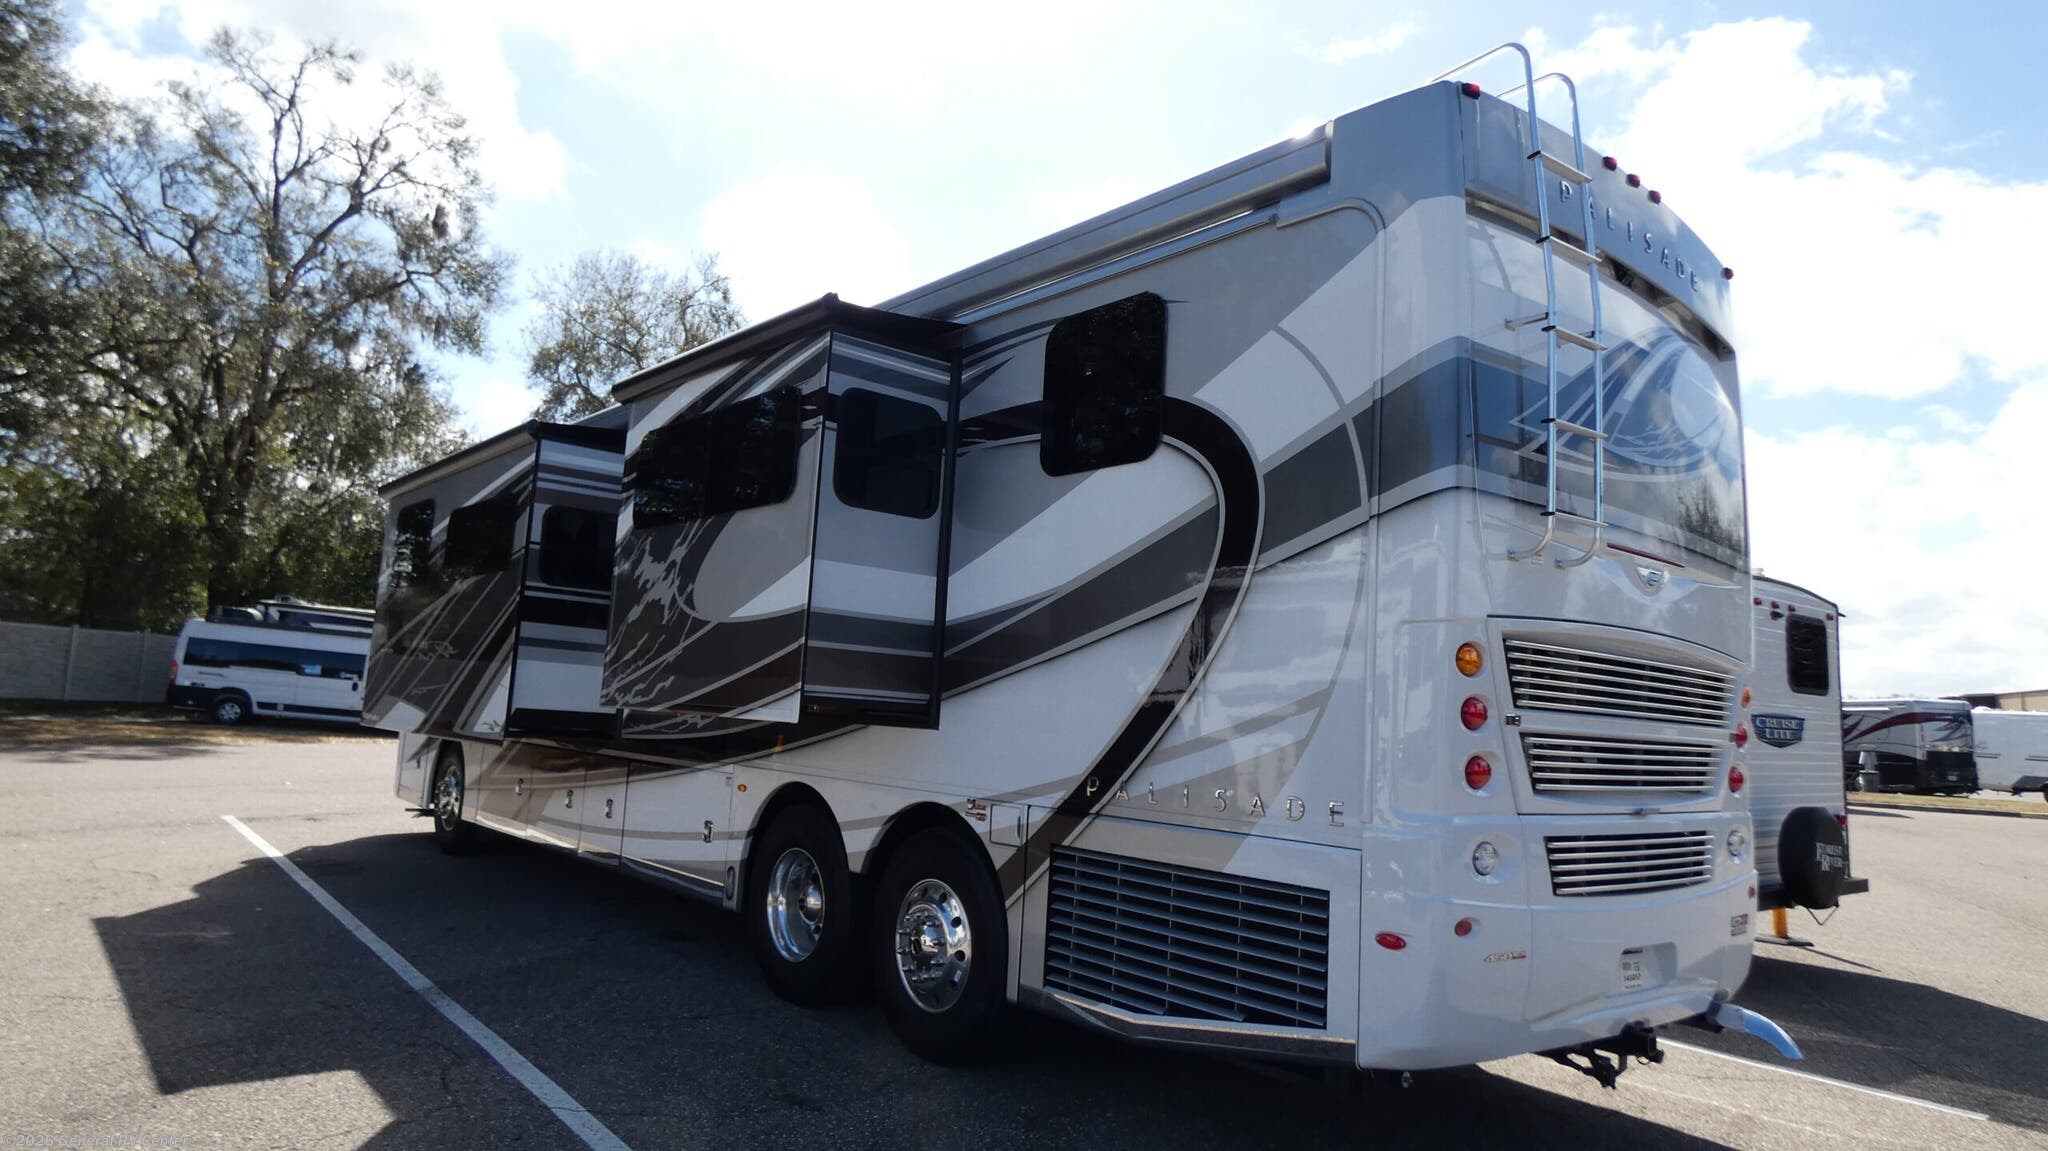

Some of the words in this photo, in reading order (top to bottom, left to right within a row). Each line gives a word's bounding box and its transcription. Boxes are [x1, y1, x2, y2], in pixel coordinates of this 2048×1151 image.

[1561, 180, 1699, 293] PALISADE
[1756, 717, 1800, 729] CRUISE
[1766, 728, 1793, 739] LITE
[1086, 776, 1345, 827] PALISADE
